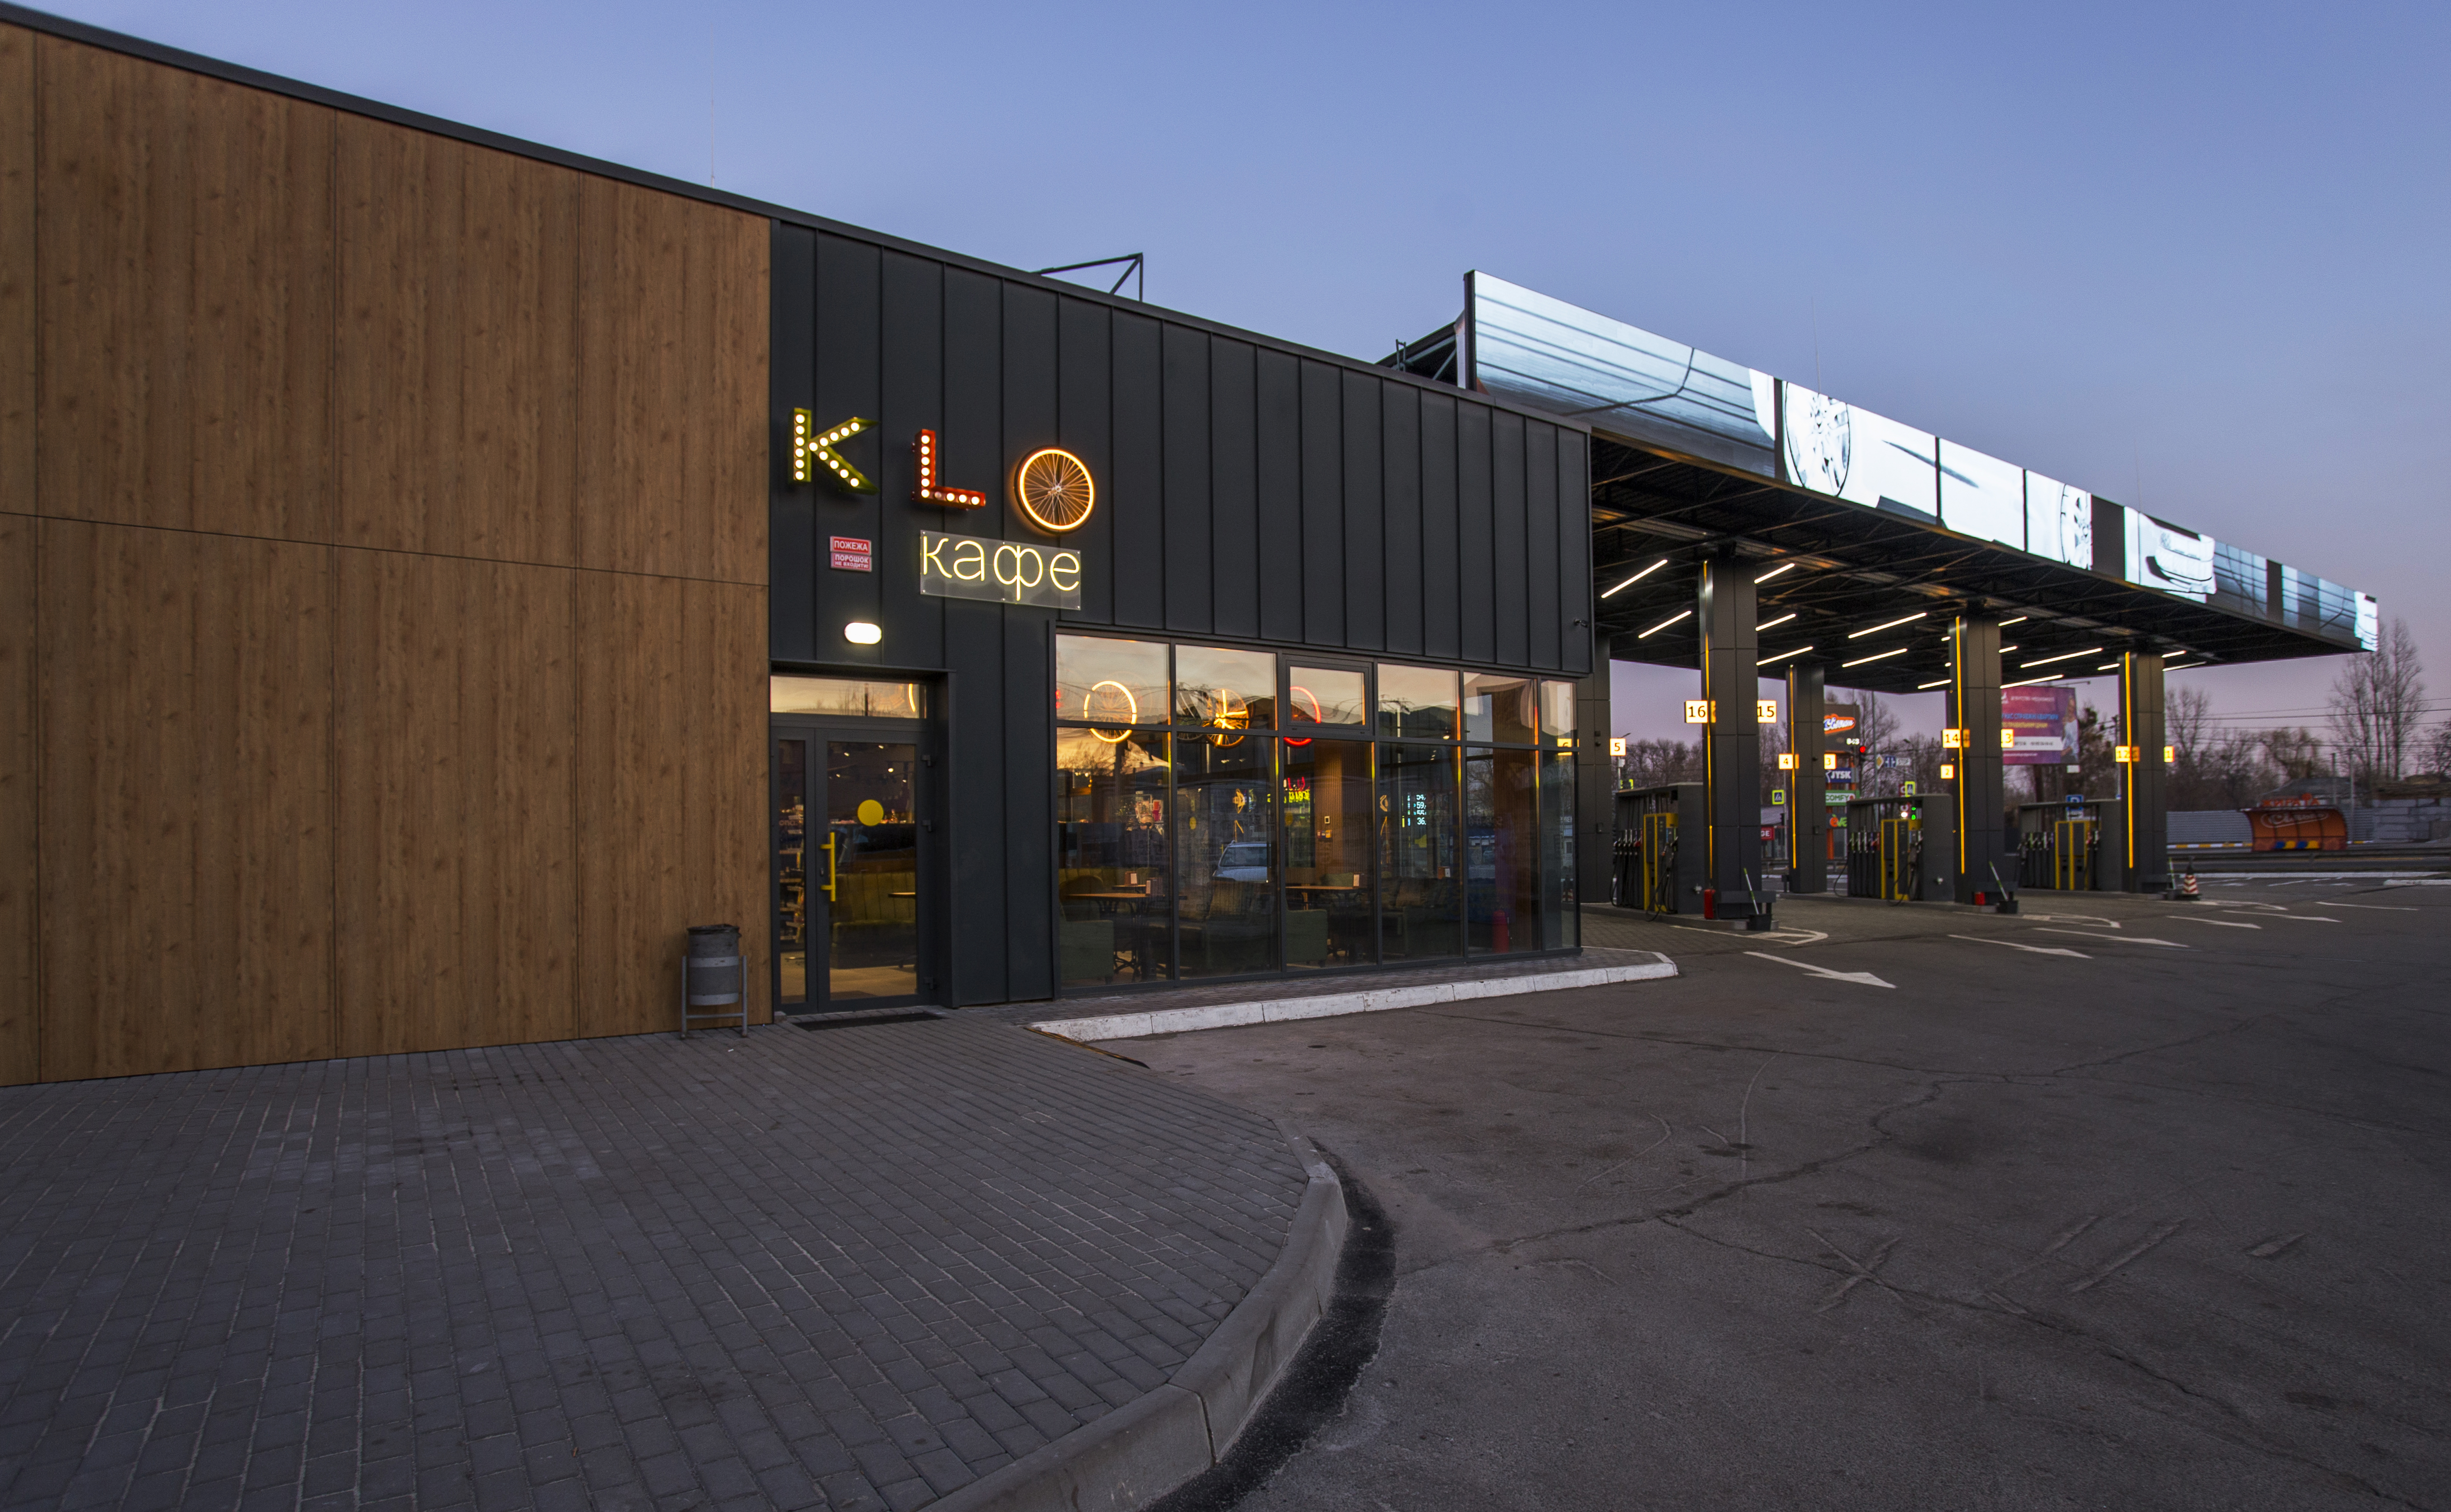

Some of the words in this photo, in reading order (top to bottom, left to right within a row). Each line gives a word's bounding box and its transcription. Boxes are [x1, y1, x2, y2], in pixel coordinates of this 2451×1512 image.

[834, 540, 867, 551] ПОЖЕЖА
[835, 554, 868, 564] ПОРОШОК
[923, 535, 1080, 601] кафе
[1688, 705, 1706, 717] 16
[1757, 706, 1775, 717] 15
[1945, 734, 1960, 743] 14
[1614, 742, 1620, 752] 5
[1826, 757, 1831, 766] 3
[1831, 771, 1851, 779] JYSK
